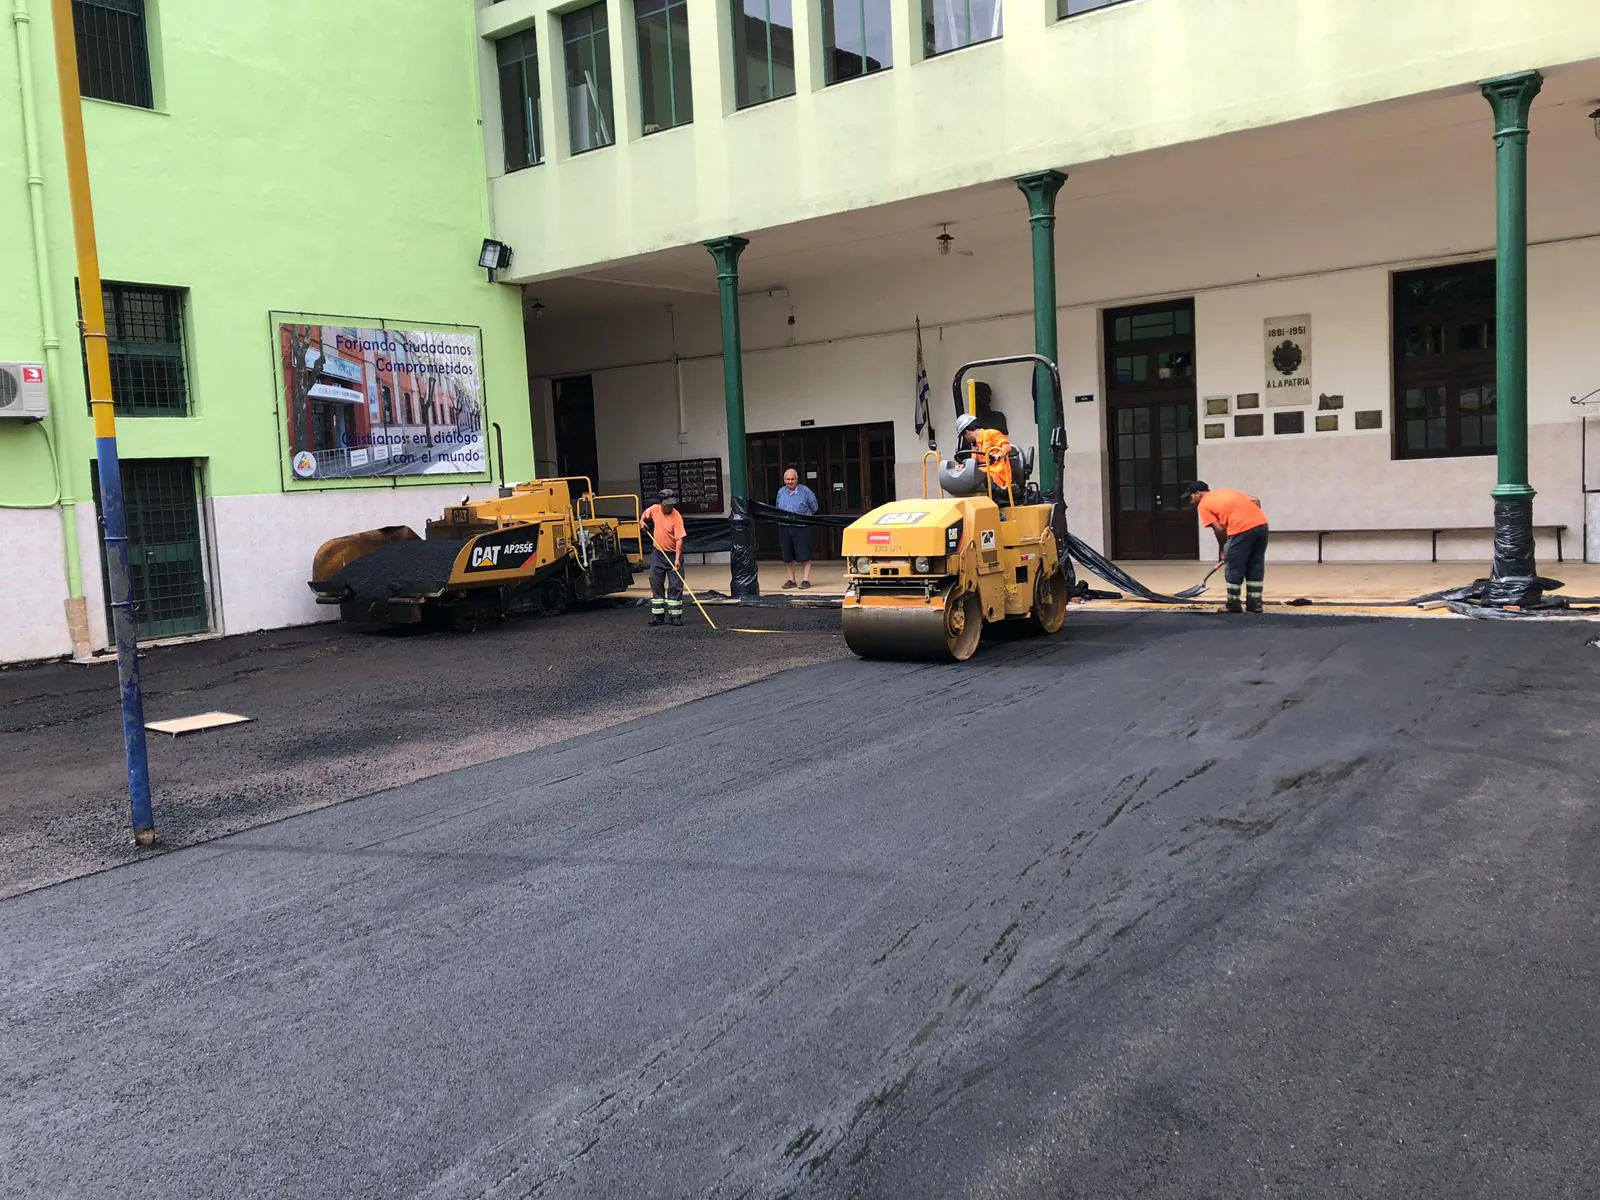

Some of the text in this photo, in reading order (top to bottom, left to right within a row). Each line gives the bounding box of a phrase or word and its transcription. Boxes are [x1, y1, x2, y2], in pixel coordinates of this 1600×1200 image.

[1268, 326, 1306, 337] 1881-1951
[336, 335, 471, 356] Forjando ciudadanos
[376, 358, 473, 375] Comprometidos
[1284, 377, 1310, 387] PATRIA
[413, 433, 427, 444] en
[434, 428, 478, 446] diálogo
[393, 453, 415, 465] con
[421, 450, 432, 463] el
[438, 449, 480, 463] mundo
[453, 509, 468, 520] CAT
[472, 543, 534, 567] CAT AP255E
